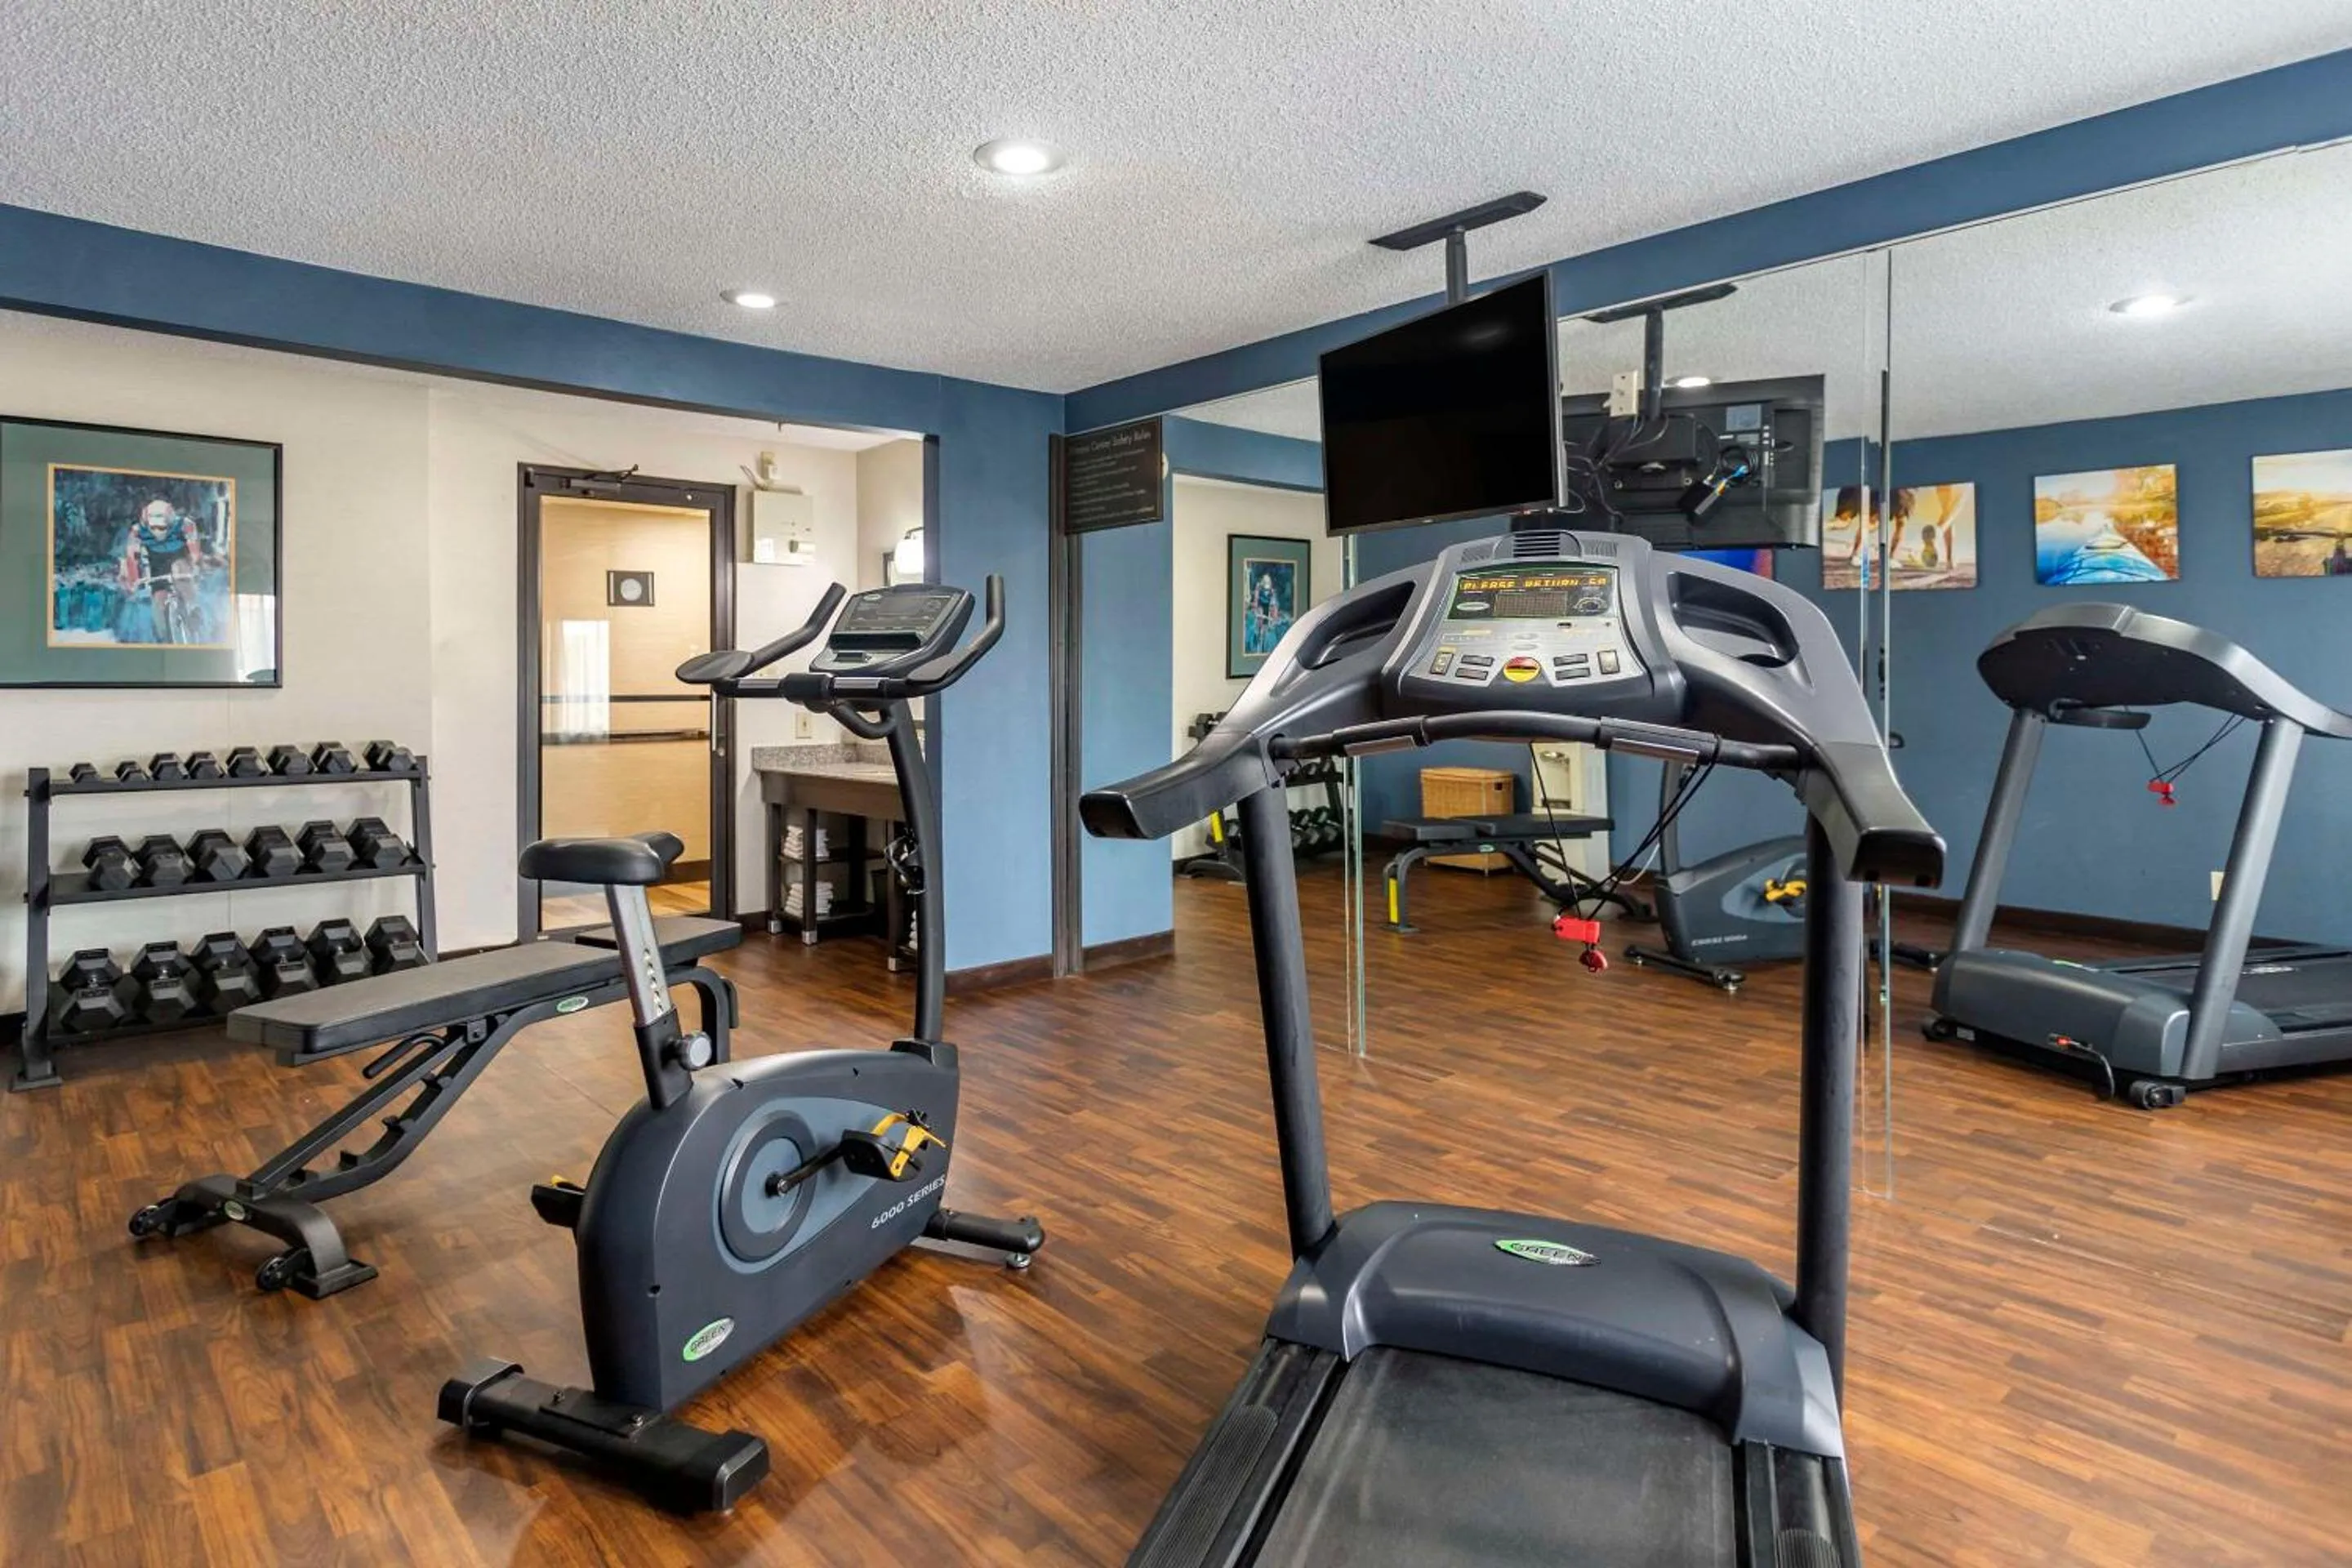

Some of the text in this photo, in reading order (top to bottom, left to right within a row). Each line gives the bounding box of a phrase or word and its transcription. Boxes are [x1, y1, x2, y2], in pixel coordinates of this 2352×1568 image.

[1463, 580, 1517, 590] PLEASE
[871, 1174, 945, 1229] 6000 SERIES
